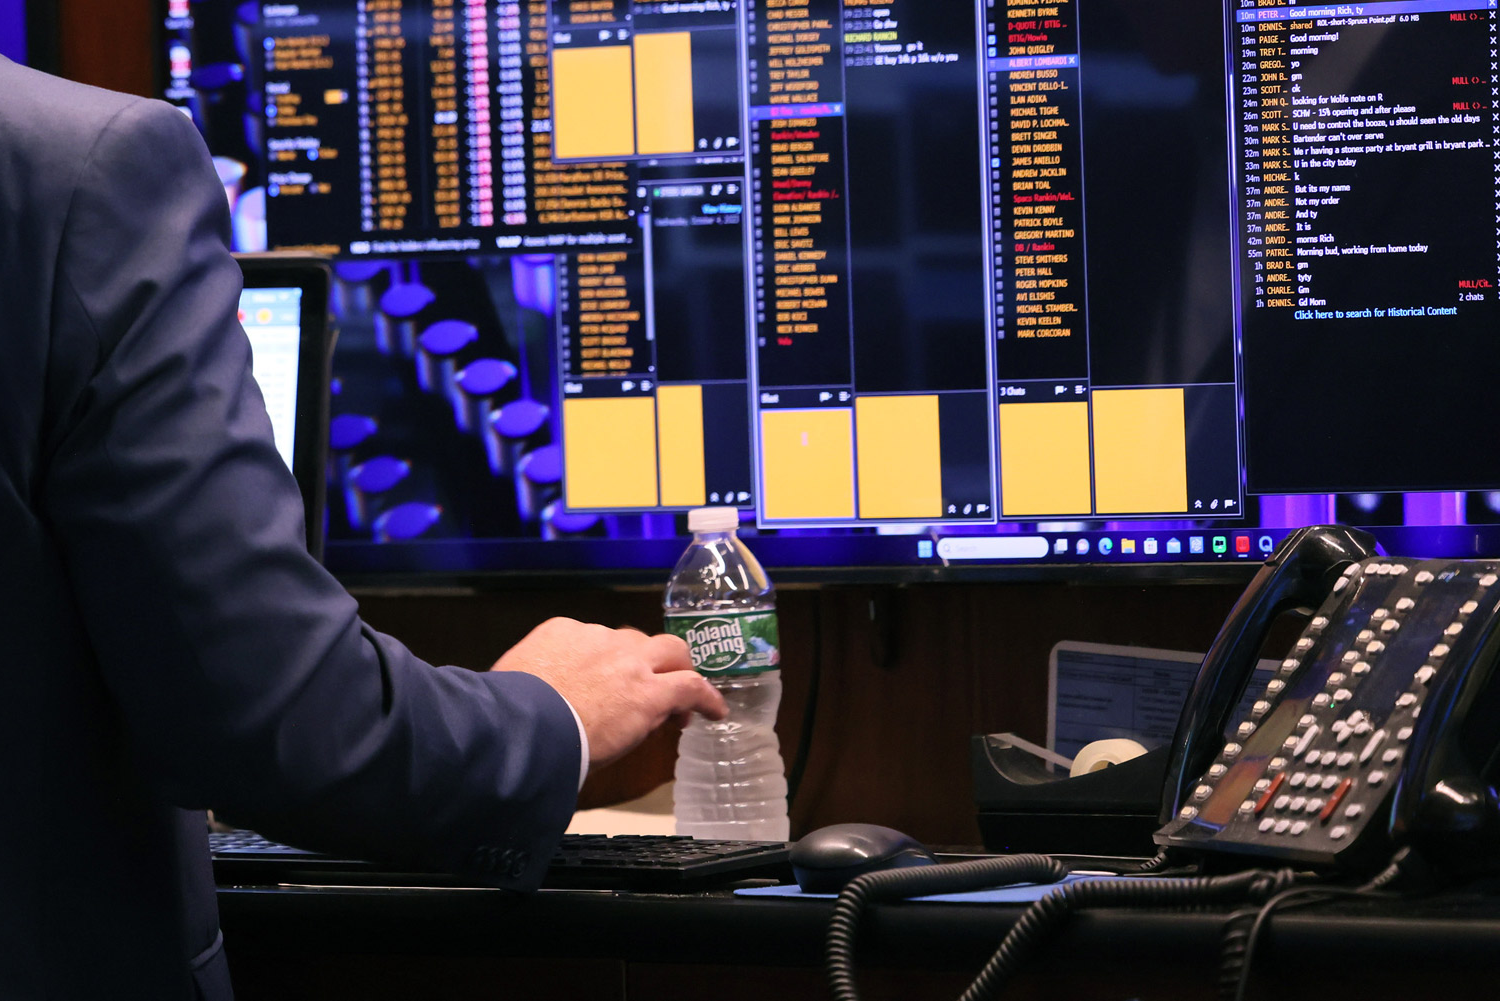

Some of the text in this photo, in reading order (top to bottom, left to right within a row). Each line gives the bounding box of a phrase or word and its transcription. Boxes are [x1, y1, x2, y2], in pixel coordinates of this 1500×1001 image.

[1289, 9, 1305, 17] Good
[1308, 7, 1336, 16] morning
[1290, 21, 1313, 30] shared
[1290, 34, 1307, 42] Good
[1322, 159, 1336, 168] city
[1338, 158, 1356, 167] today
[1459, 292, 1484, 301] 2 chats
[1294, 306, 1457, 320] Click here to search for Historical Content
[685, 617, 742, 648] Poland
[689, 634, 746, 667] Spring
